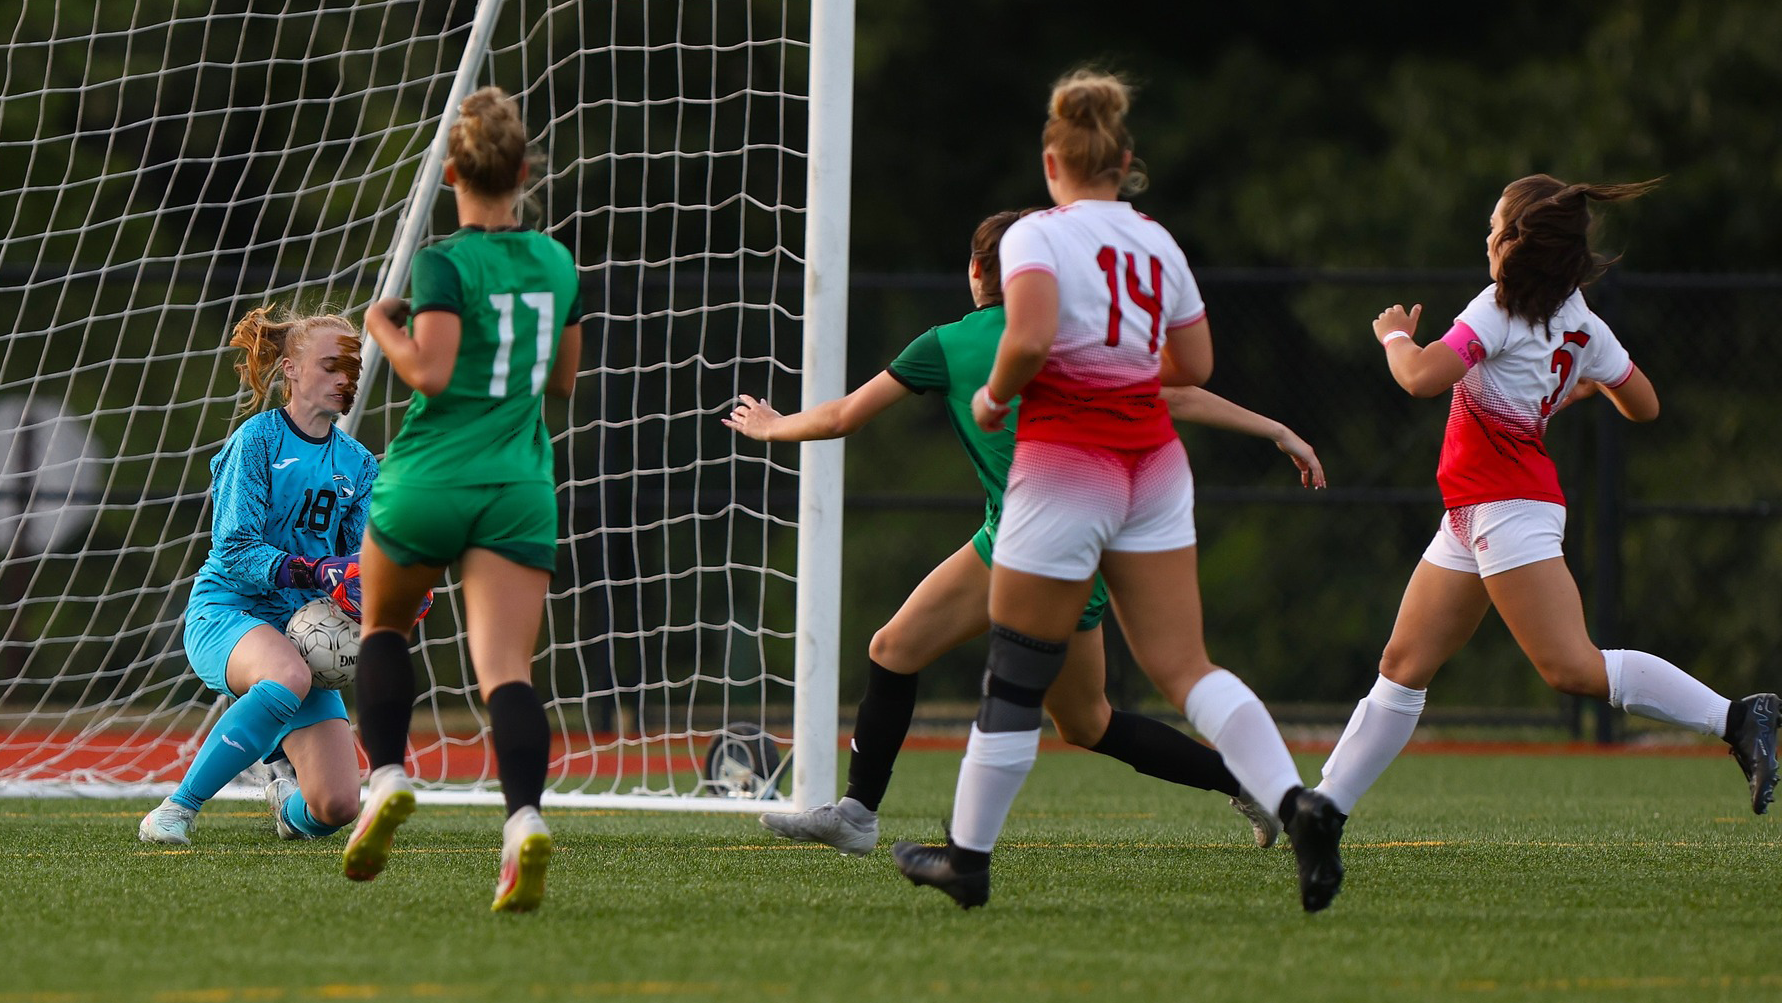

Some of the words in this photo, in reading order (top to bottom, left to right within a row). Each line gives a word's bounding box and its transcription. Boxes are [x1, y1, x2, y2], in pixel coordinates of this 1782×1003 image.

[488, 291, 555, 397] 11
[1097, 245, 1163, 354] 14
[294, 488, 337, 532] 18
